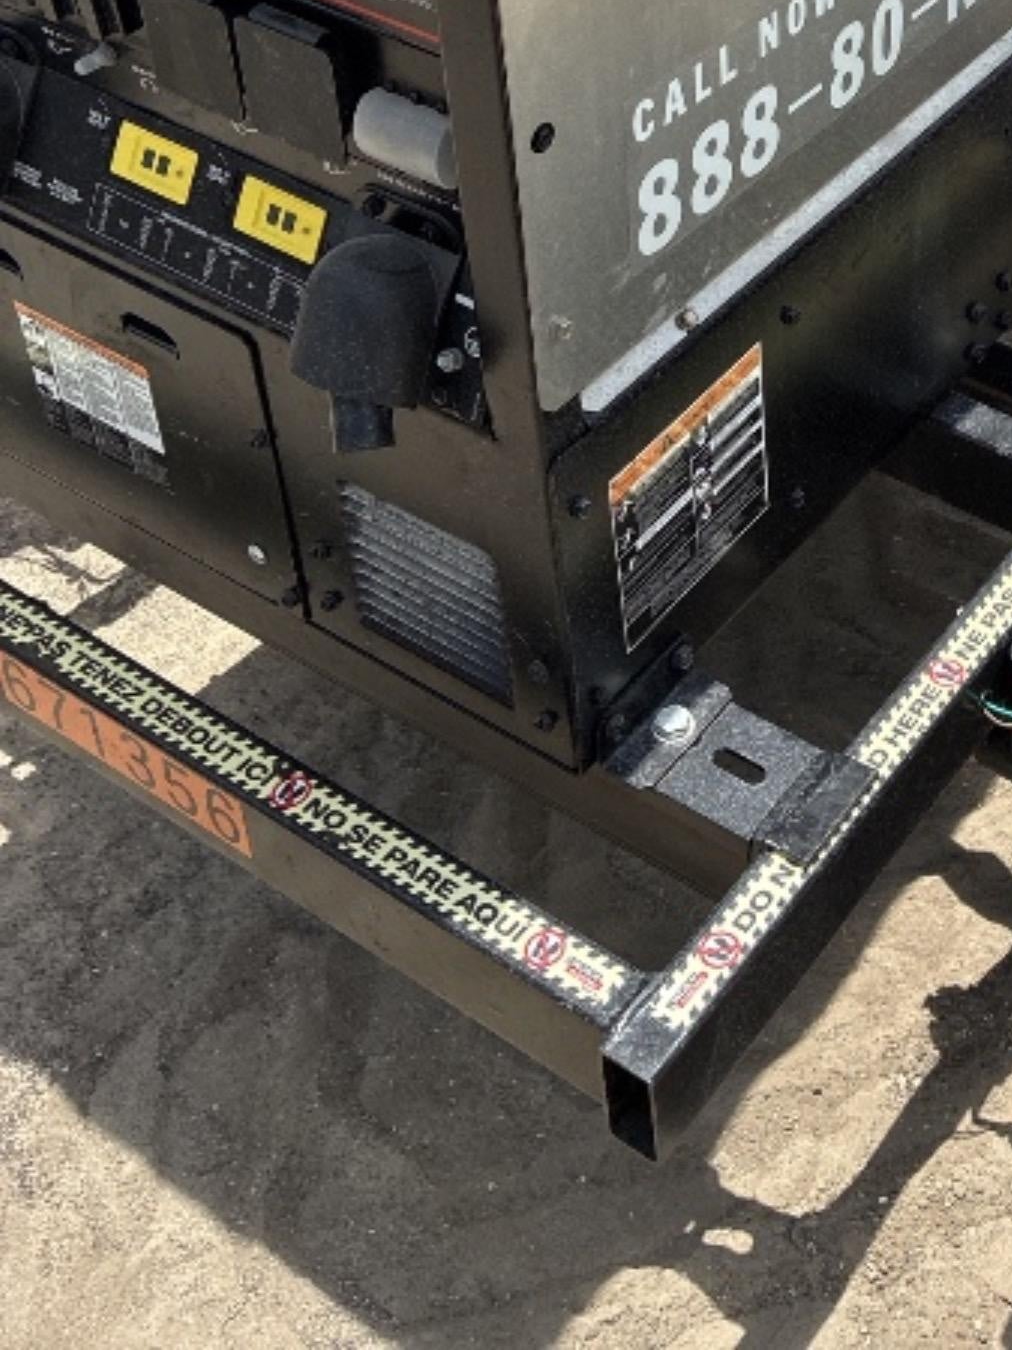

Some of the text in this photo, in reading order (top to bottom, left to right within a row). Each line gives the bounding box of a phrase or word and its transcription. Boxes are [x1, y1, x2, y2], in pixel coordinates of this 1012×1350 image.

[631, 44, 738, 143] CALL
[954, 629, 988, 662] NE
[20, 615, 72, 659] PAS
[69, 650, 146, 700] TENEZ
[140, 697, 243, 771] DEBOUT
[235, 756, 277, 787] ICI
[882, 683, 943, 747] HERE
[303, 797, 349, 831] NO
[348, 821, 389, 857] SE
[384, 844, 460, 903] PARE
[732, 890, 774, 933] DO
